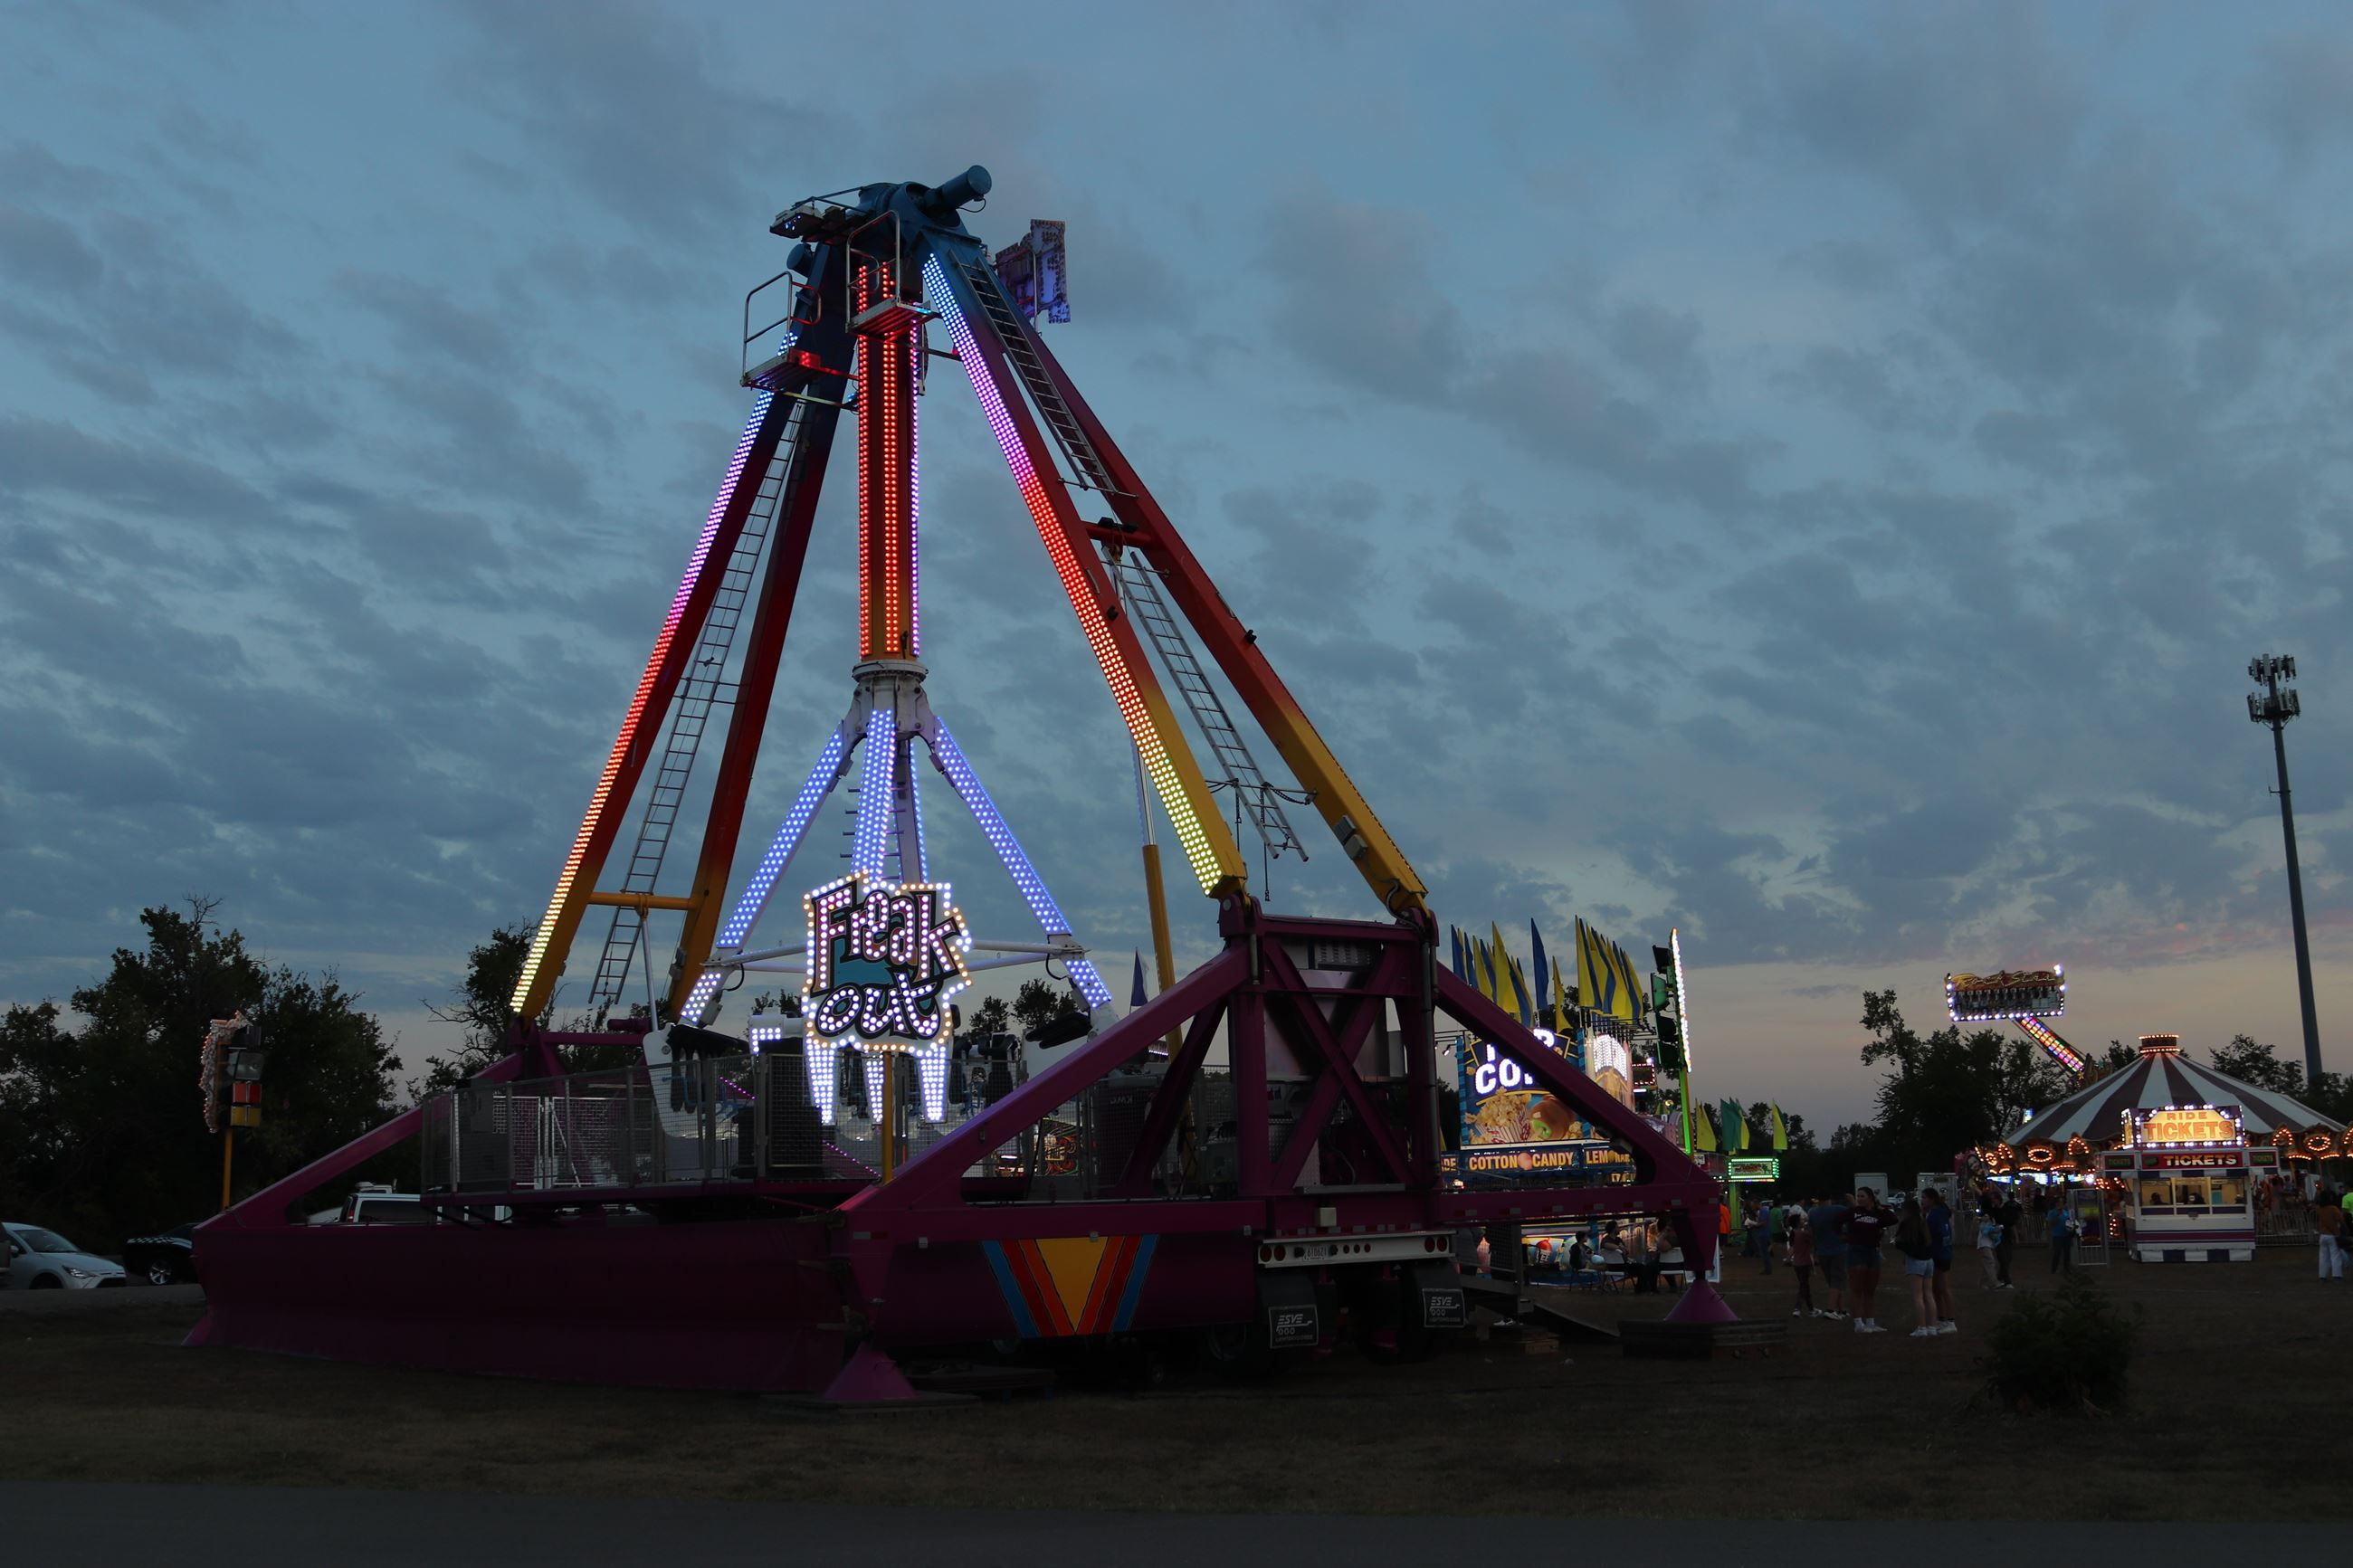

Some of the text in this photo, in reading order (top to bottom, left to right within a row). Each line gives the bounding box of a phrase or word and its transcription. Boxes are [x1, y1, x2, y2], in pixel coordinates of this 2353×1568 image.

[811, 881, 959, 997] Freak
[816, 968, 946, 1038] out
[2167, 1112, 2208, 1121] RIDE
[2143, 1121, 2234, 1141] TICKETS
[1469, 1152, 1574, 1171] COTTON CANDY
[2163, 1154, 2237, 1166] TICKETS
